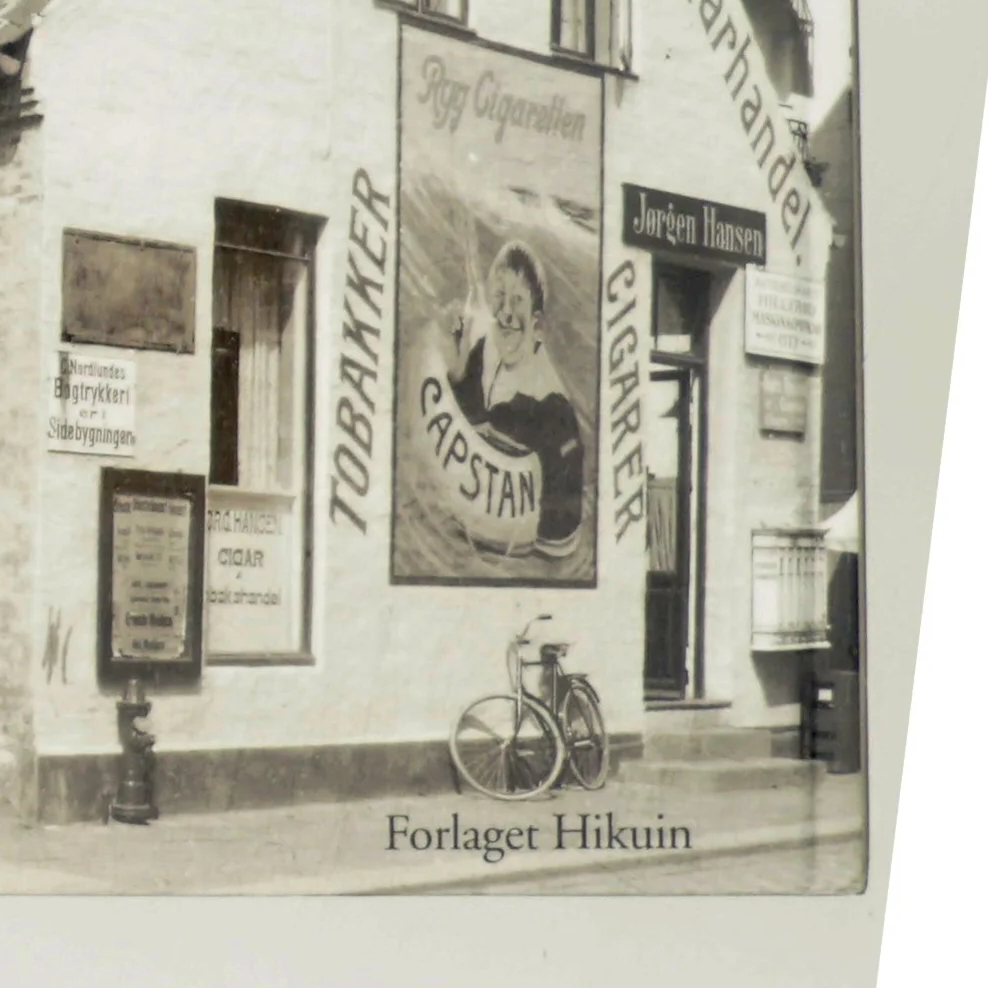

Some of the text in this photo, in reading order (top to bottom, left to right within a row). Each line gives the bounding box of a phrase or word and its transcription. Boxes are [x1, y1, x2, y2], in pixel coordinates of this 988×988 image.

[633, 192, 763, 257] Jørgen Hansen
[329, 166, 391, 536] TOBAKKER
[607, 259, 646, 545] CIGARER
[420, 376, 535, 518] CAPSTAN
[385, 813, 693, 863] Forlaget Hikuin
